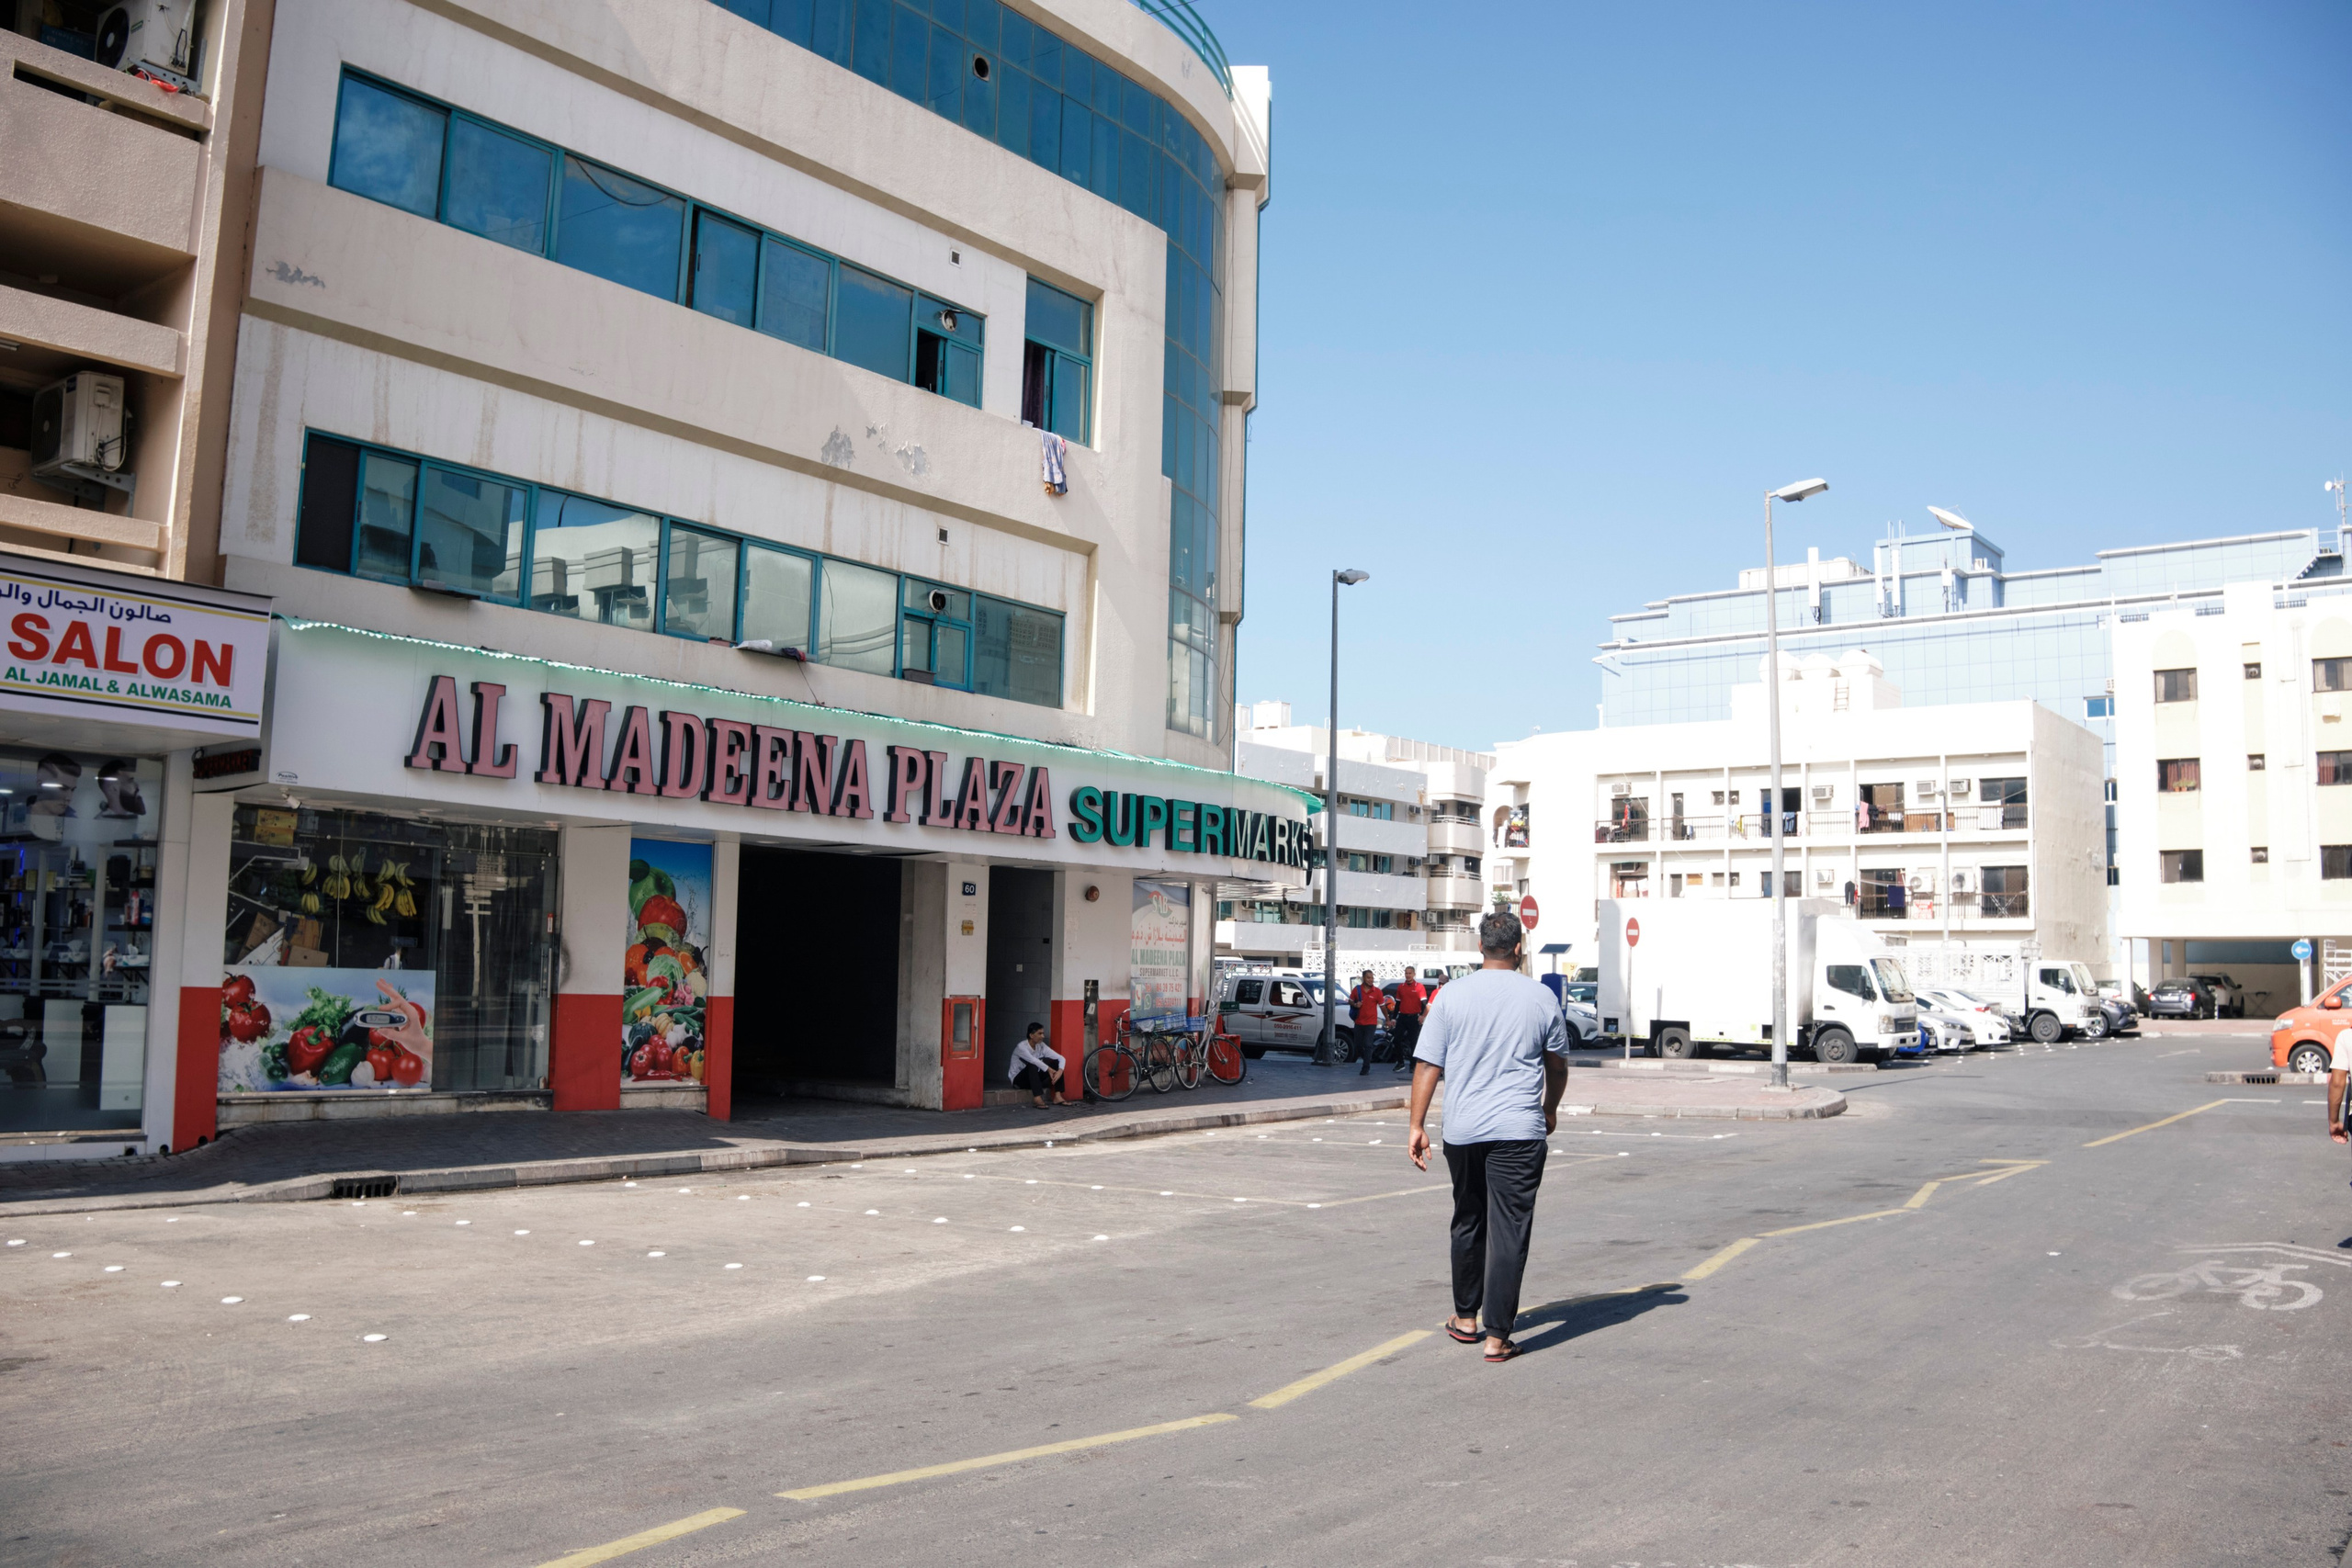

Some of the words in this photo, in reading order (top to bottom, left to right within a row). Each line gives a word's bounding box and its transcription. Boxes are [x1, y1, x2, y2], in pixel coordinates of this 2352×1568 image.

[0, 583, 31, 605] وال
[38, 590, 105, 614] الجمال
[109, 602, 172, 624] صالون
[7, 613, 234, 688] SALON
[5, 666, 30, 682] AL
[36, 671, 103, 691] JAMAL
[107, 680, 119, 693] &
[127, 682, 232, 708] ALWASAMA
[404, 675, 518, 779] AL
[535, 693, 874, 819] MADEENA
[883, 745, 1056, 839] PLAZA
[1068, 786, 1309, 871] SUPERMARKE
[965, 885, 975, 893] 60
[1131, 949, 1138, 964] AL
[1139, 949, 1168, 965] MADEENA
[1169, 951, 1185, 966] PLAZA
[1139, 967, 1168, 976] SUPERMARKET
